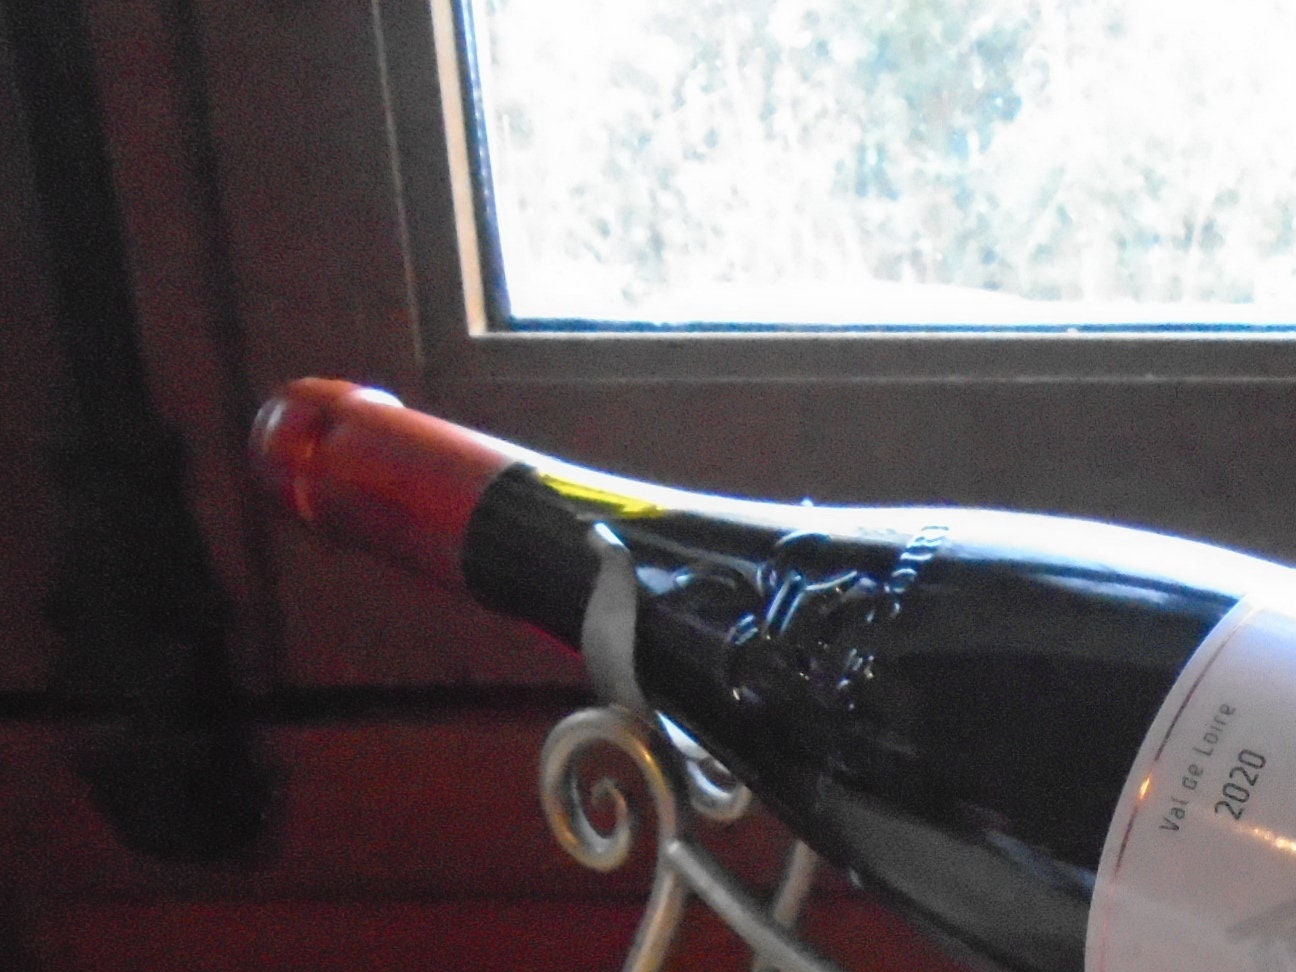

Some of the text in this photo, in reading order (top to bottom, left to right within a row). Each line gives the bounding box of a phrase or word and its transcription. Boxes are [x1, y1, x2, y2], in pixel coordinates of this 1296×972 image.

[1158, 703, 1238, 832] Val de Loire
[1214, 749, 1267, 821] 2020
